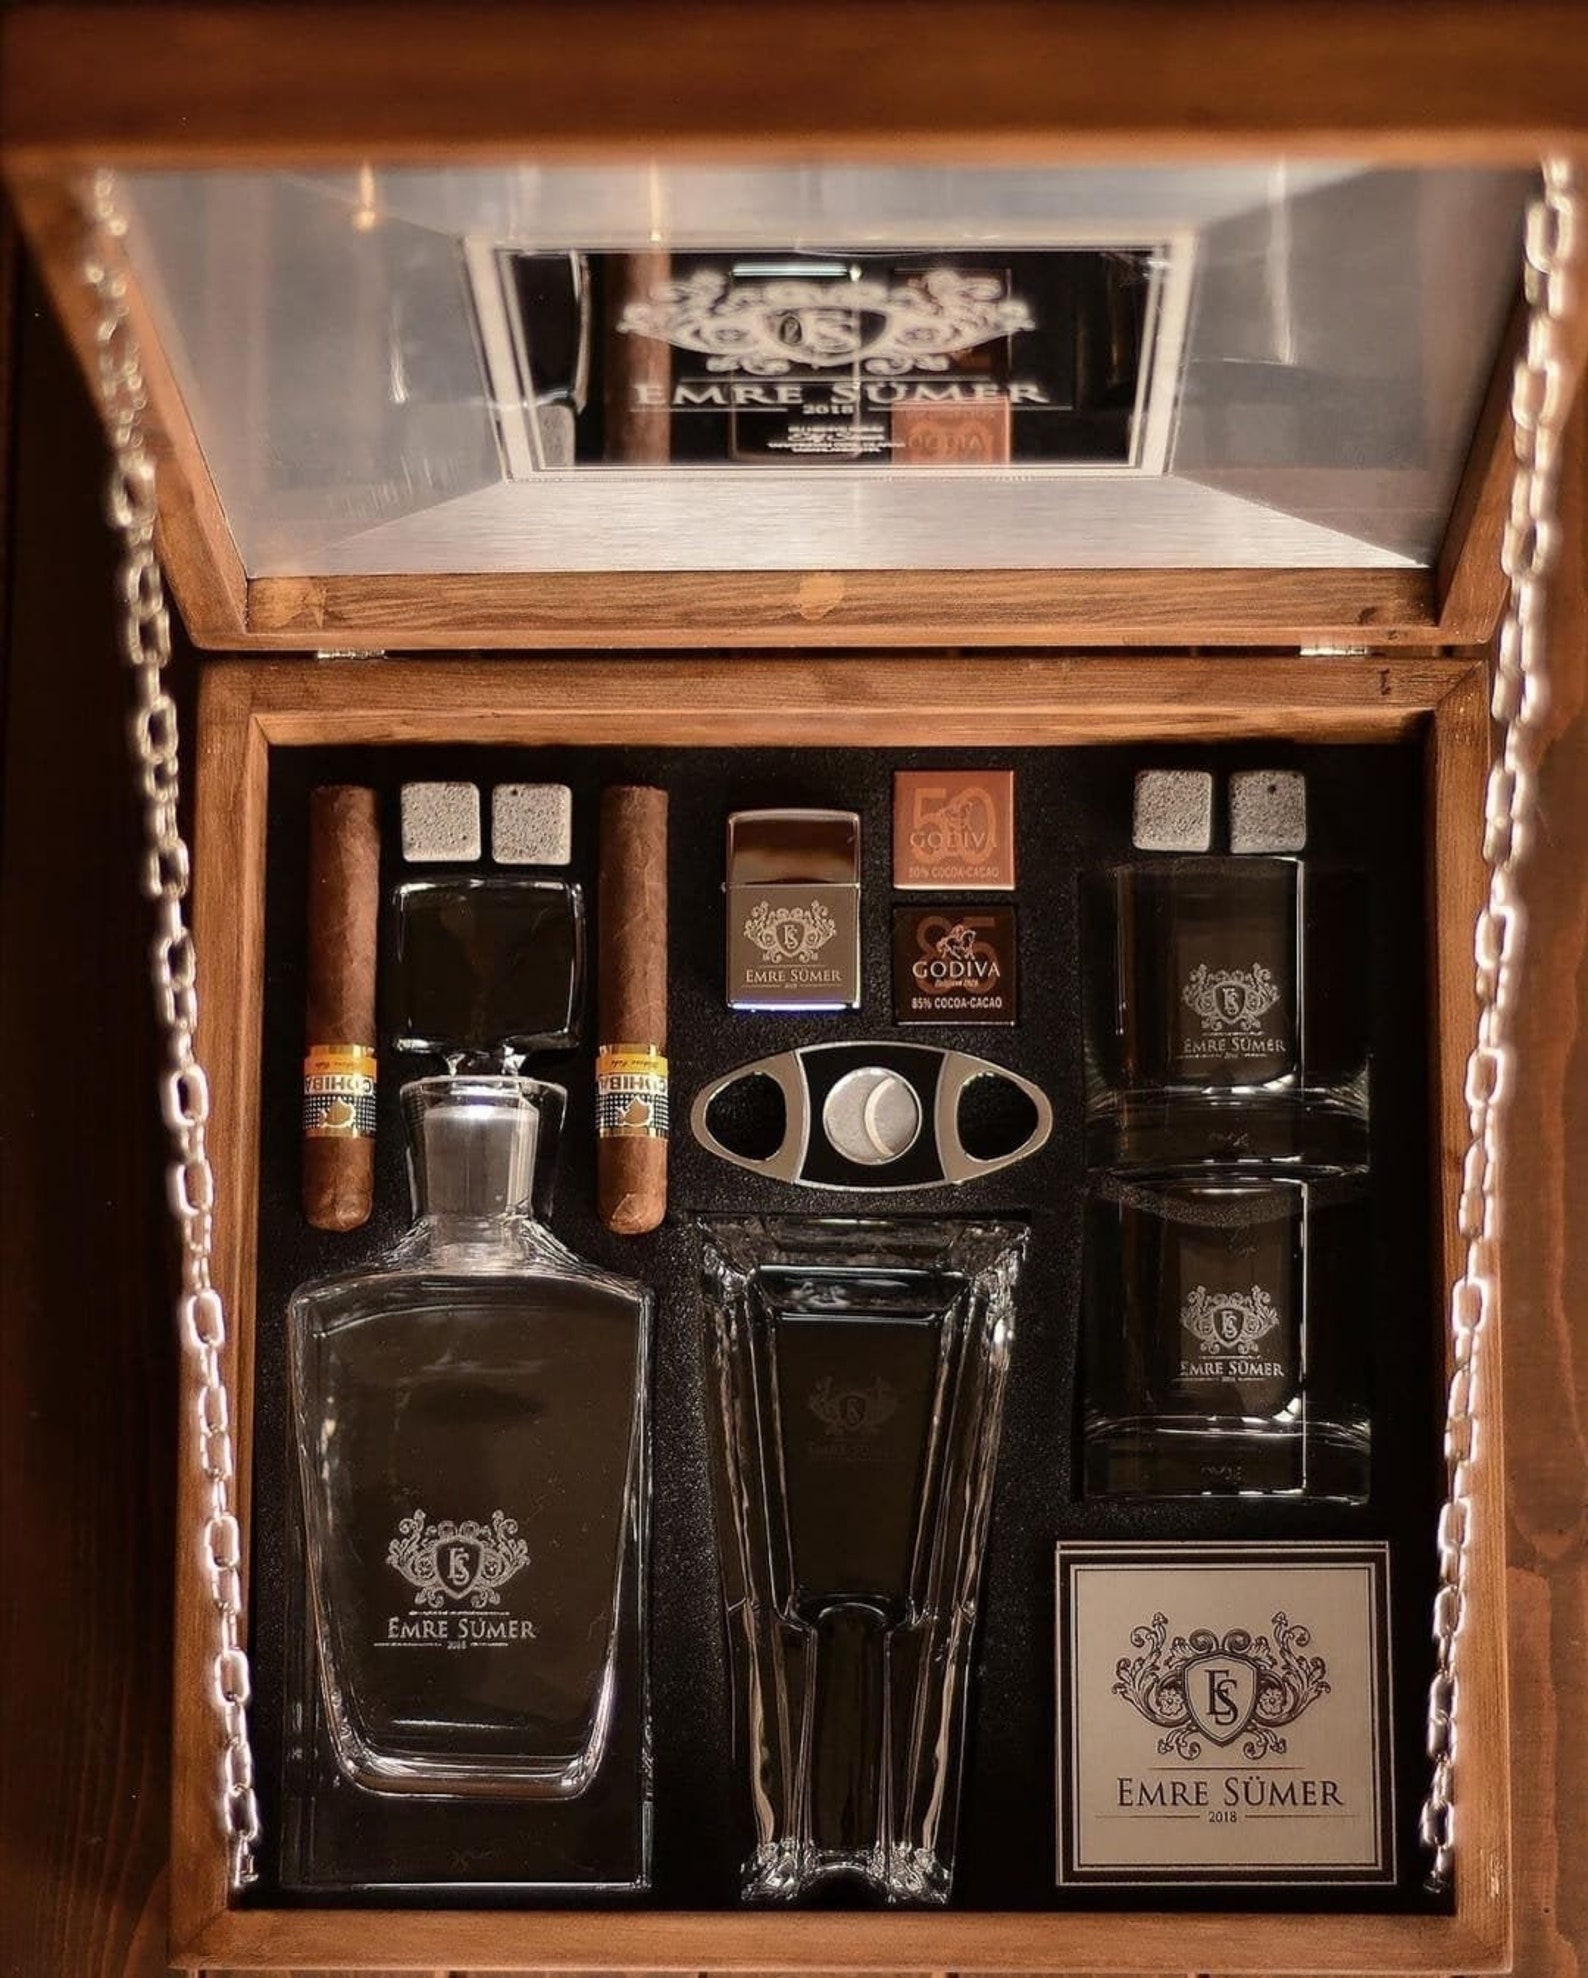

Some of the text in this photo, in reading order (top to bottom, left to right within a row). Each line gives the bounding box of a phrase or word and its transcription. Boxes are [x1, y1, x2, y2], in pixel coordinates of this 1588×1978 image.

[634, 381, 1049, 405] EMRE SÜMER
[802, 404, 854, 415] 2018
[746, 969, 786, 983] EMRE
[912, 961, 1001, 979] GODIVA
[1183, 1038, 1226, 1054] EMRE
[305, 1075, 372, 1094] COHIBA
[601, 1075, 666, 1093] COHIBA
[1180, 1361, 1224, 1376] EMRE
[387, 1616, 448, 1639] EMRE
[1116, 1775, 1344, 1806] EMRE SÜMER
[1208, 1810, 1238, 1823] 2018
